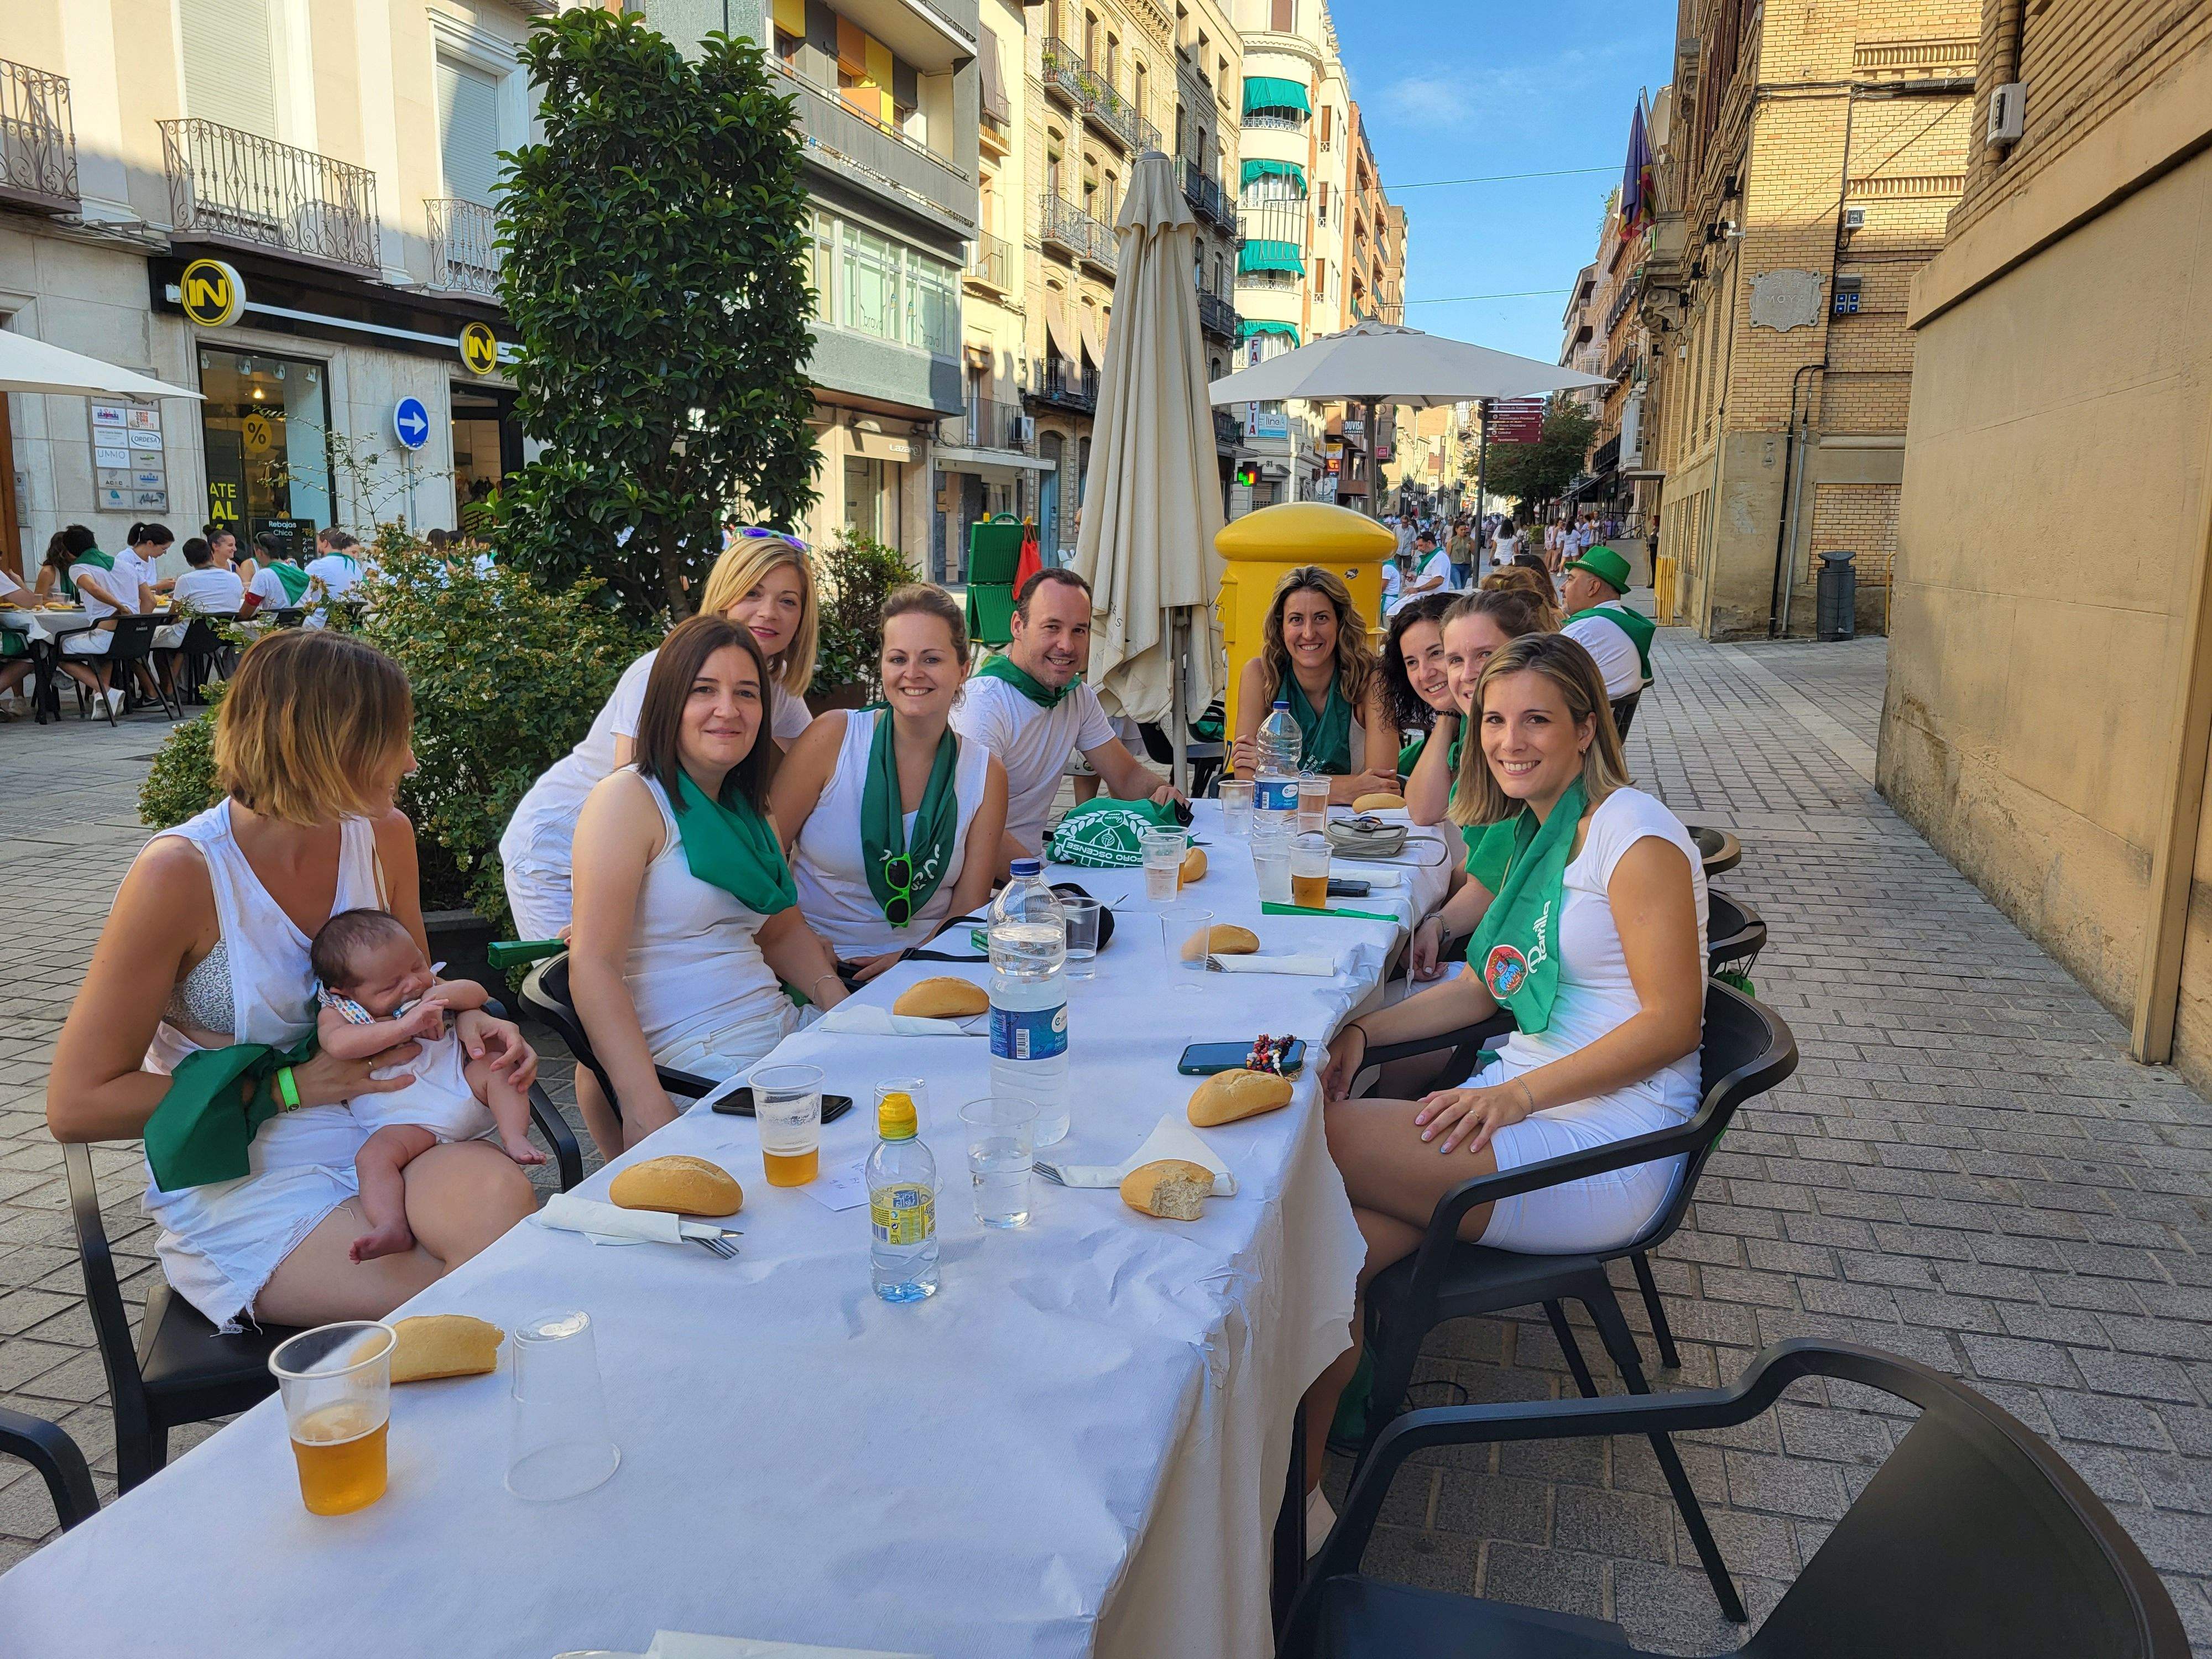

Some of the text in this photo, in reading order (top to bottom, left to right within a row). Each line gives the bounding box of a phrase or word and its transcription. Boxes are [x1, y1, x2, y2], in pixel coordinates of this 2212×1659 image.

[189, 279, 227, 307] IN
[468, 336, 492, 361] IN
[1344, 421, 1363, 430] DUVISA
[134, 435, 158, 444] ORDESA
[268, 520, 297, 529] Rebajas
[1066, 842, 1113, 859] OSCENSE
[1527, 900, 1551, 974] Parrilla
